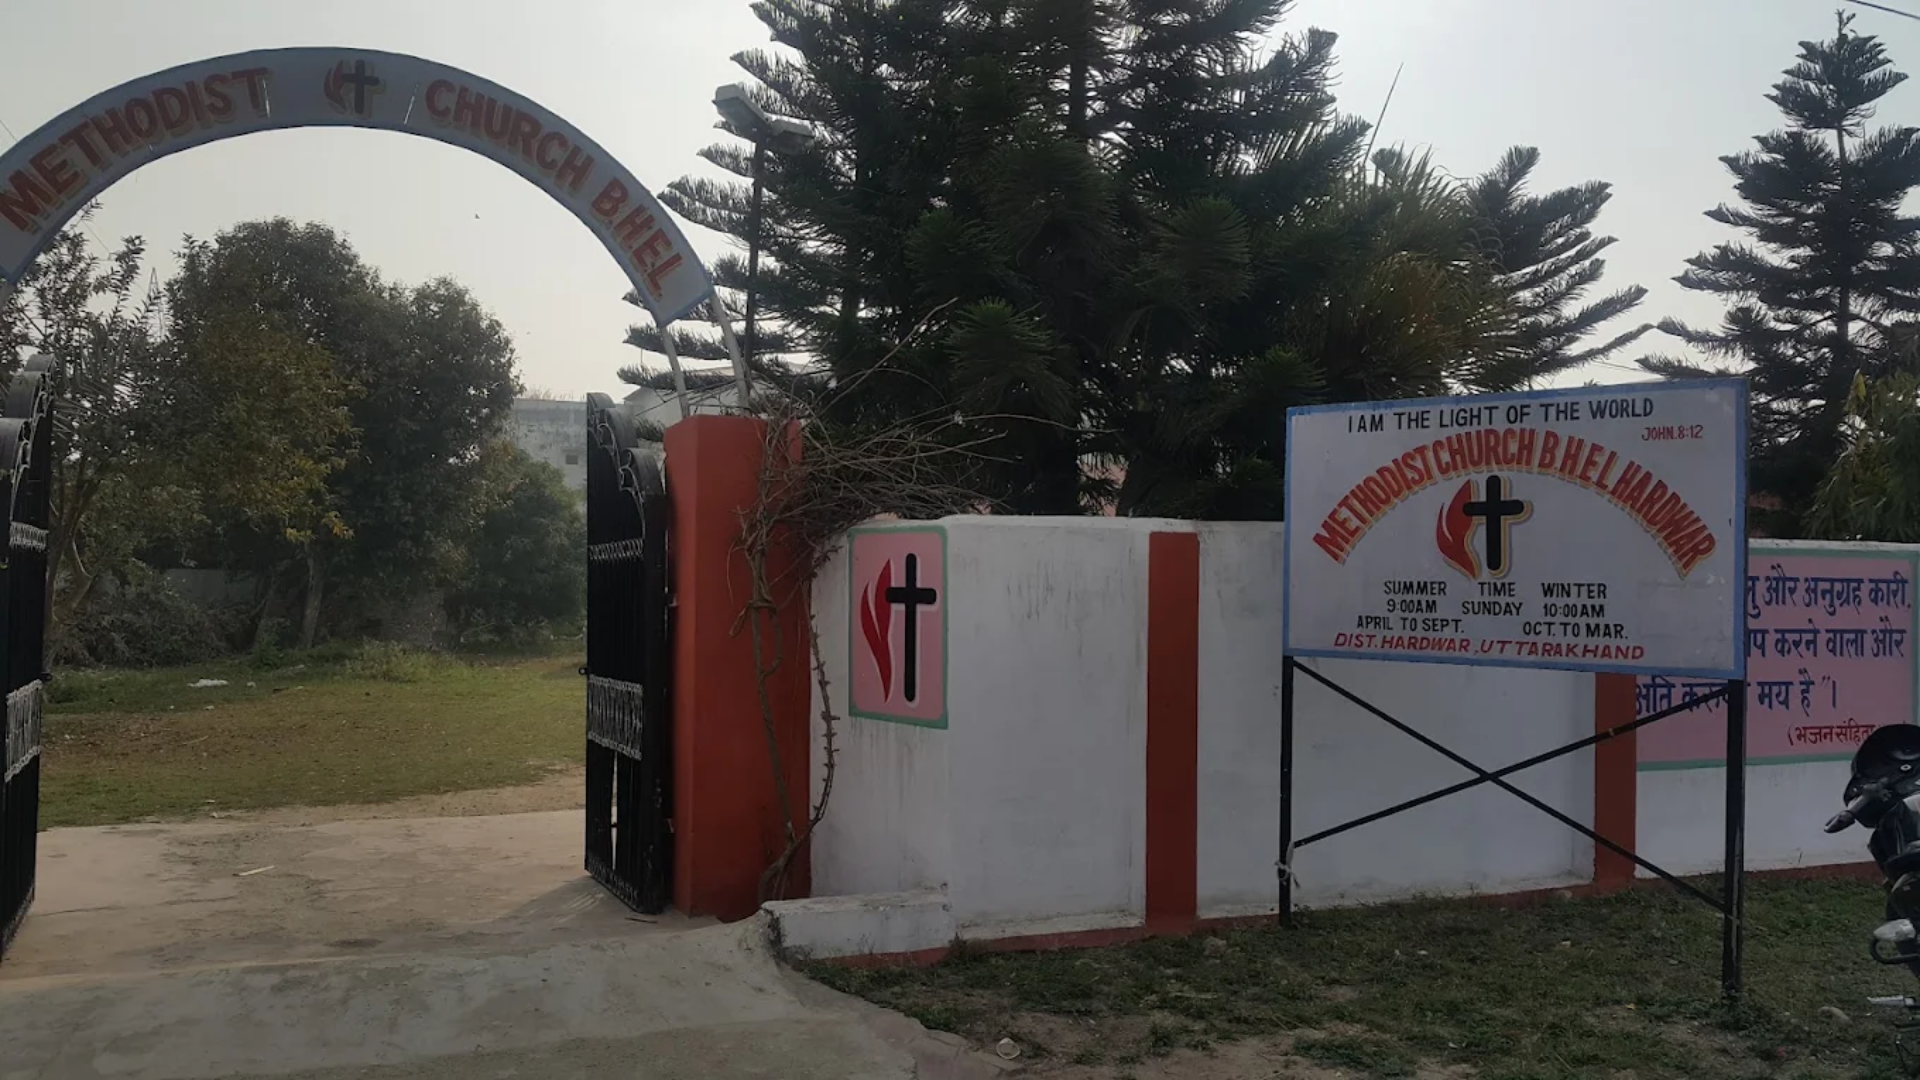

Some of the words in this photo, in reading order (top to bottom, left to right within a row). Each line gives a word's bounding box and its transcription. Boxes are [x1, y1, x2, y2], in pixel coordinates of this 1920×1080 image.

[0, 67, 271, 233] METHODIST
[425, 79, 595, 195] CHURCH
[1348, 416, 1352, 433] I
[1357, 414, 1384, 433] AM
[1393, 411, 1431, 430] THE
[1439, 406, 1499, 428] LIGHT
[1506, 405, 1531, 424] OF
[1540, 402, 1580, 422] THE
[1588, 398, 1654, 419] WORLD
[1312, 445, 1435, 564] METHODIST
[1432, 427, 1537, 475] CHURCH
[1610, 460, 1716, 573] HARDWAR
[1383, 580, 1447, 596] SUMMER
[1477, 582, 1516, 597] TIME
[1541, 582, 1608, 599] WINTER
[1762, 563, 1800, 607] और
[1356, 615, 1394, 630] APRIL
[1400, 617, 1418, 632] TO
[1422, 618, 1465, 633] SEPT.
[1522, 621, 1556, 637] OCT.
[1559, 622, 1581, 638] TO
[1585, 623, 1629, 639] MAR.
[1461, 601, 1523, 616] SUNDAY
[1774, 618, 1820, 658] करने
[1825, 628, 1867, 658] वाला
[1871, 616, 1907, 658] और
